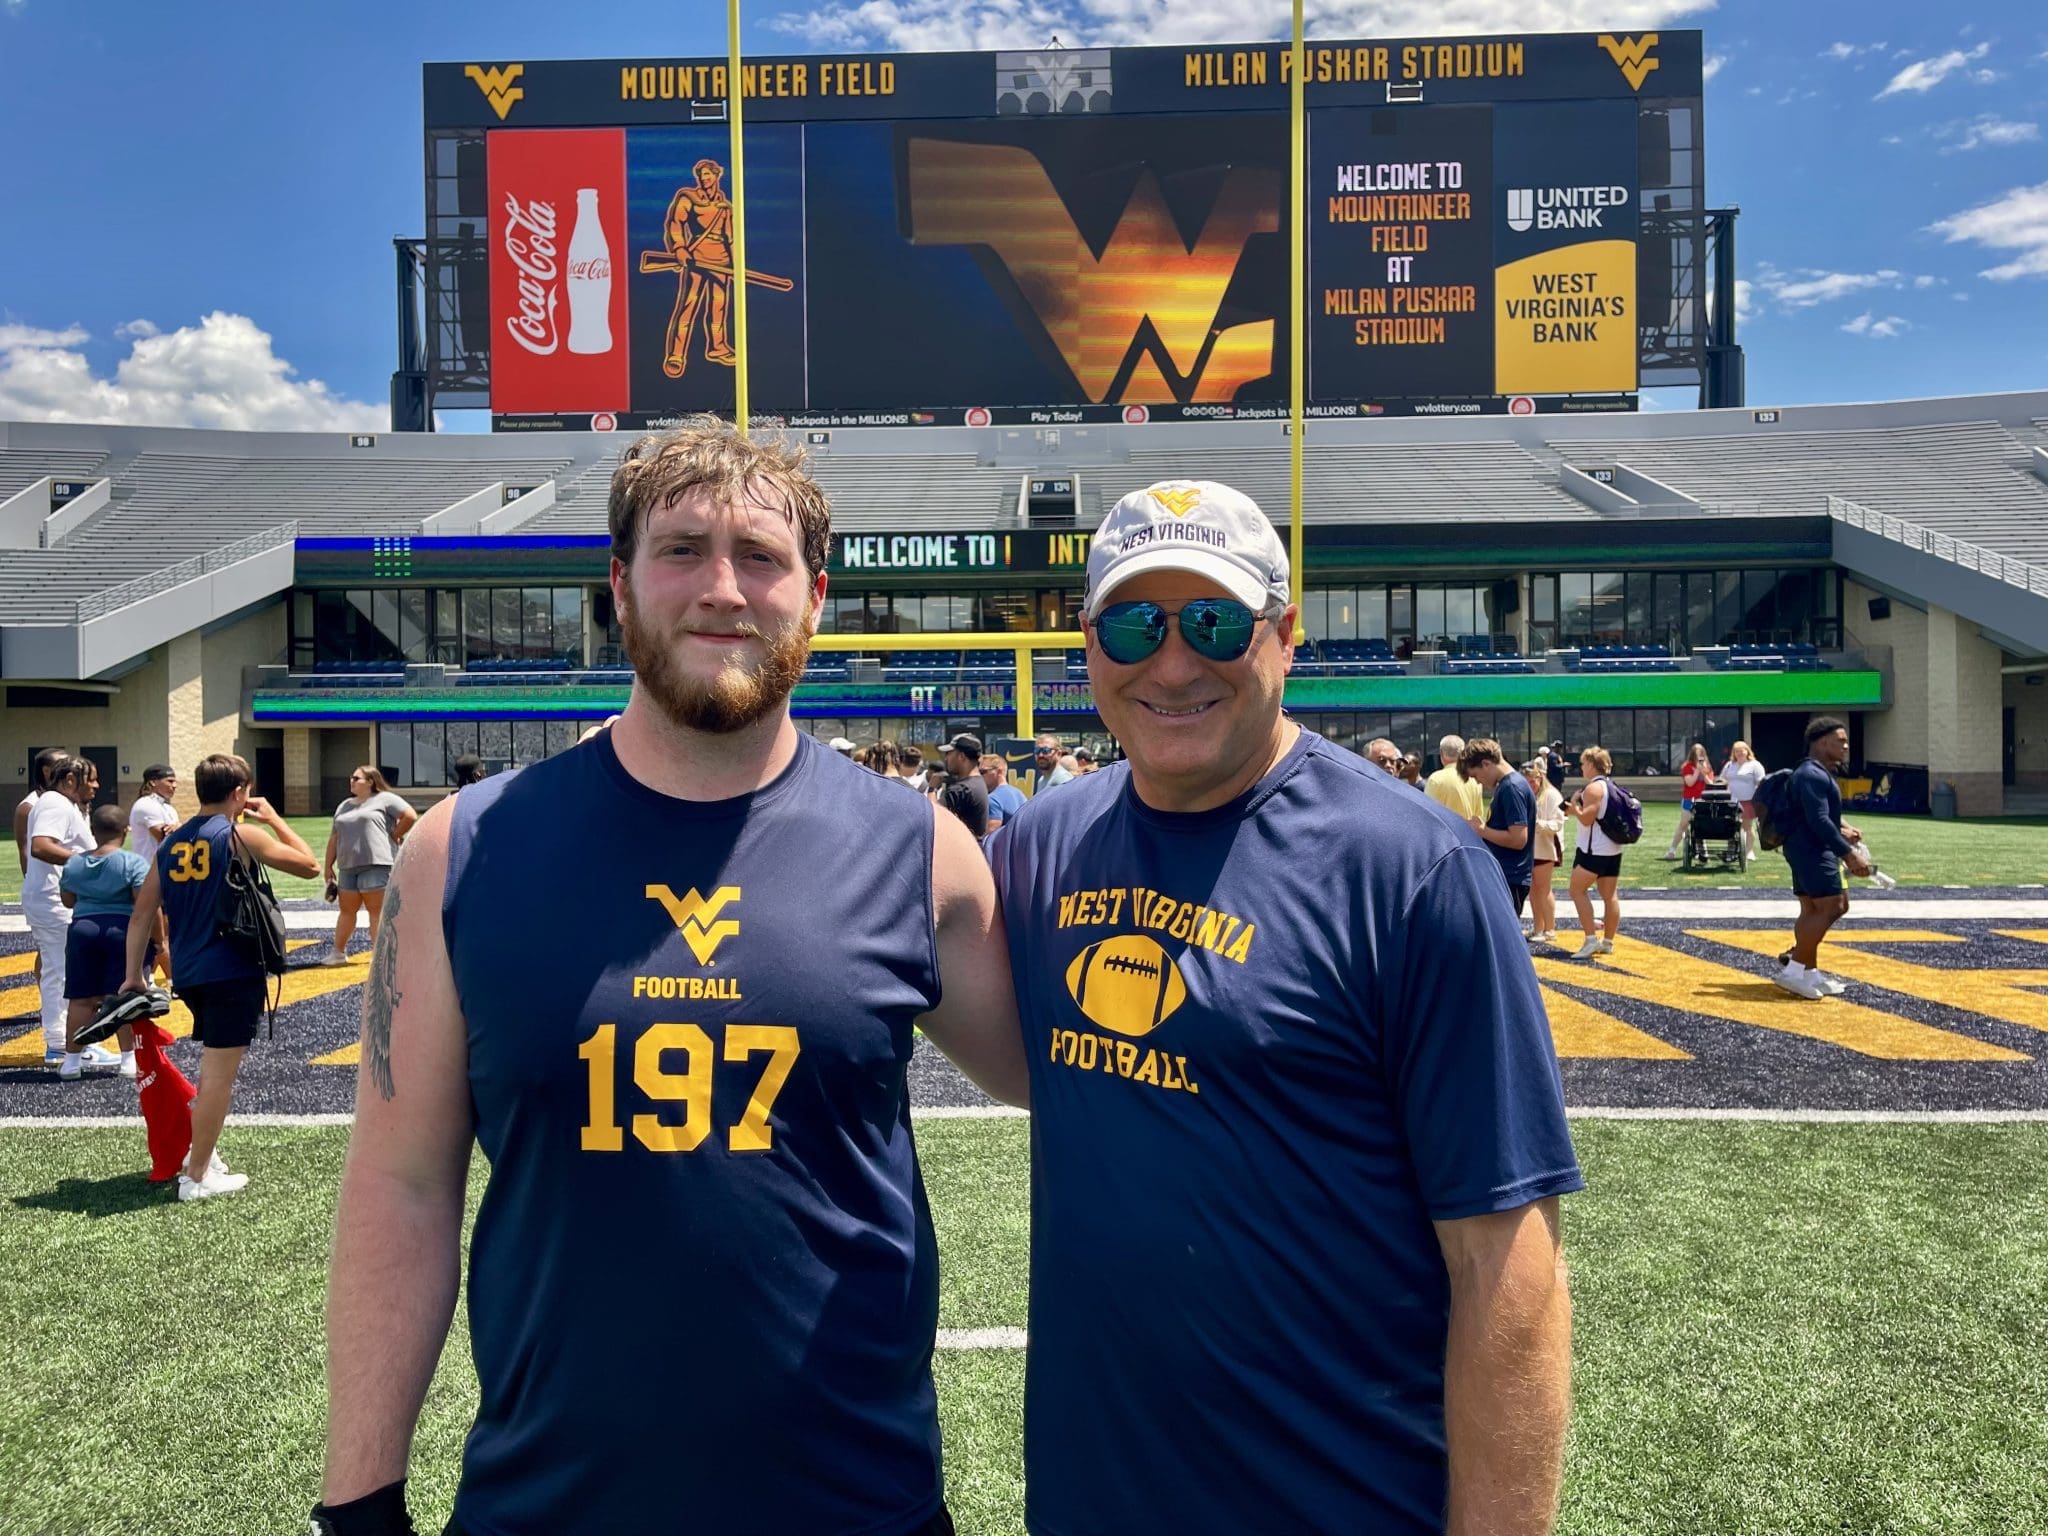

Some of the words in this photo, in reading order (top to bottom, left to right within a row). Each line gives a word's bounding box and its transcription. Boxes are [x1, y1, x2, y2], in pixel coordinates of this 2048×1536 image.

[1185, 51, 1267, 86] MILAN
[1280, 47, 1388, 84] PUSKAR
[1402, 42, 1524, 79] STADIUM
[621, 64, 807, 99] MOUNTANEER
[820, 62, 895, 96] FIELD
[1337, 164, 1432, 191] WELCOME
[1436, 162, 1462, 189] TO
[1329, 193, 1471, 222] MOUNTAINEER
[1537, 186, 1629, 208] UNITED
[1537, 208, 1602, 229] BANK
[1372, 225, 1428, 252] FIELD
[505, 192, 558, 355] Coca-Cola
[1387, 256, 1413, 283] AT
[1532, 273, 1598, 294] WEST
[1325, 288, 1386, 314] MILAN
[1393, 286, 1475, 313] PUSKAR
[1506, 296, 1625, 319] VIRGINIA'S
[1355, 317, 1444, 345] STADIUM
[1533, 322, 1598, 343] BANK
[790, 416, 829, 426] Jackpots
[831, 415, 840, 424] in
[842, 415, 857, 424] the
[859, 414, 908, 425] MILLIONS!
[1031, 412, 1051, 423] Play
[1053, 411, 1083, 422] Today!
[1236, 408, 1276, 418] Jackpots
[1278, 407, 1287, 417] in
[1306, 406, 1357, 416] MILLIONS!
[1415, 402, 1480, 414] wvlottery.com
[1032, 482, 1045, 493] 97
[843, 534, 959, 567] WELCOME
[964, 534, 996, 566] TO
[1119, 525, 1154, 554] WEST
[1158, 523, 1226, 549] VIRGINIA
[911, 686, 936, 712] AT
[942, 686, 1005, 712] MILAN
[169, 840, 211, 882] 33
[1058, 888, 1126, 929] WEST
[1132, 887, 1255, 964] VIRGINIA
[633, 976, 742, 999] FOOTBALL
[1051, 1027, 1199, 1094] FOOTBALL
[578, 1023, 801, 1152] 197
